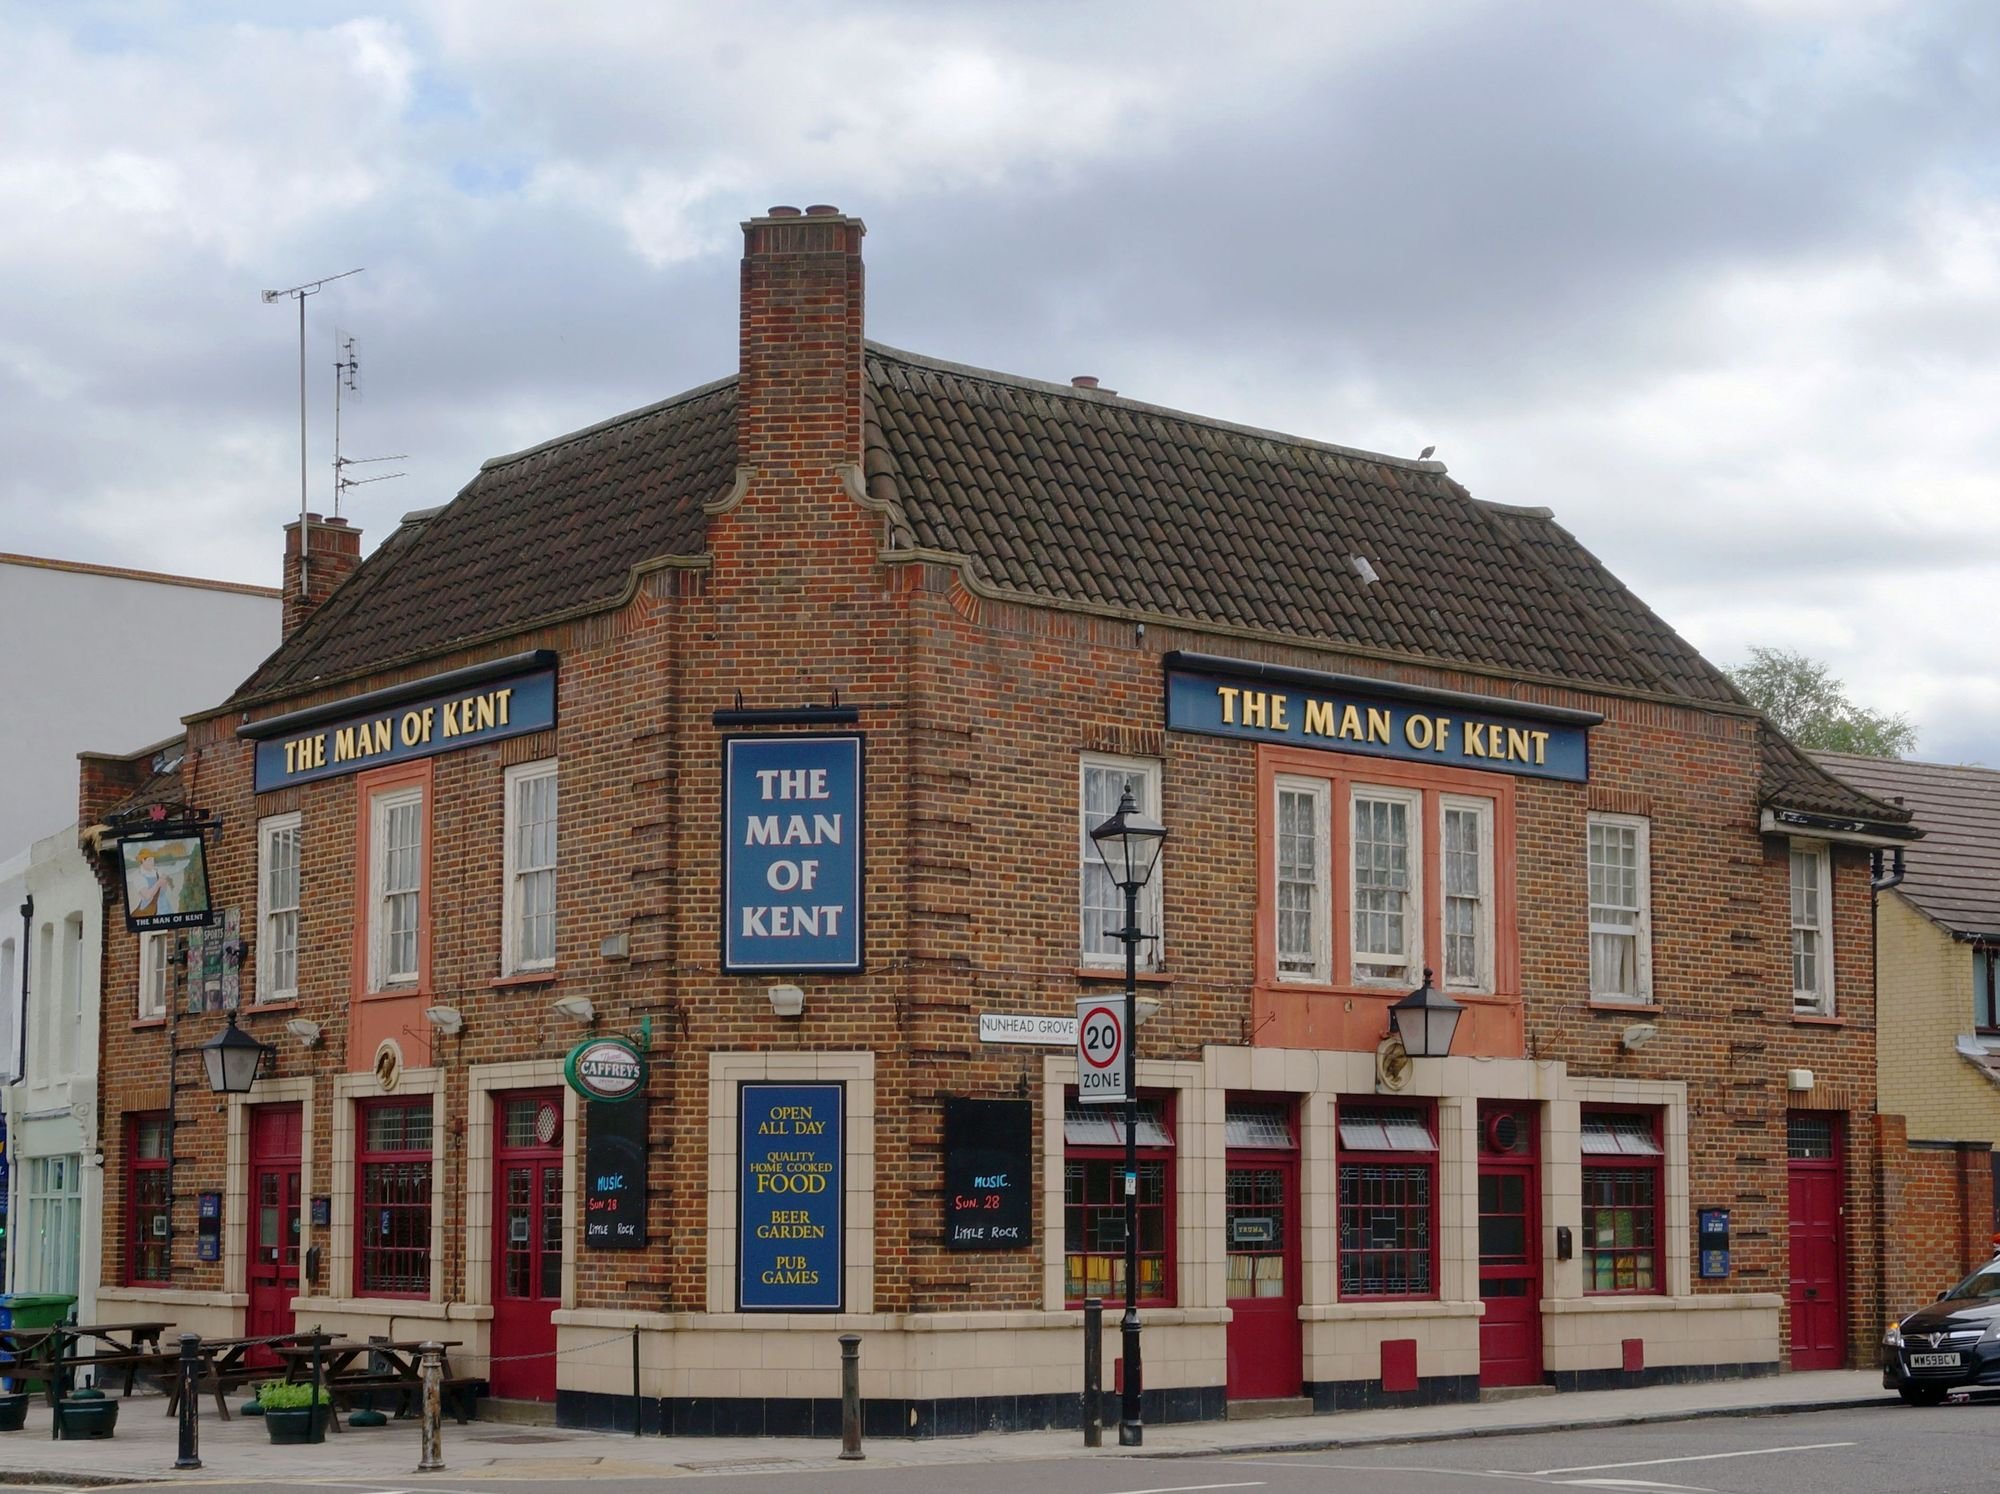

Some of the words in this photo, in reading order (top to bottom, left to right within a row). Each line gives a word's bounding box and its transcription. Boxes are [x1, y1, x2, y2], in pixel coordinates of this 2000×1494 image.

[284, 733, 327, 774] THE
[333, 717, 393, 763] MAN
[400, 706, 436, 747] OF
[442, 688, 512, 738] KENT
[1217, 686, 1290, 731] THE
[1303, 698, 1391, 745] MAN
[1404, 713, 1451, 752] OF
[1462, 721, 1550, 765] KENT
[755, 768, 830, 800] THE
[744, 813, 842, 845] MAN
[766, 859, 819, 891] OF
[135, 918, 150, 926] THE
[152, 916, 170, 924] MAN
[185, 913, 204, 921] KENT
[741, 904, 844, 937] KENT
[204, 927, 224, 941] SPORTS
[981, 1018, 1035, 1033] NUNHEAD
[1038, 1020, 1074, 1034] GROVE
[1086, 1025, 1115, 1050] 20
[1083, 1072, 1121, 1088] ZONE
[769, 1106, 813, 1120] OPEN
[758, 1121, 789, 1135] ALL
[795, 1121, 826, 1135] DAY
[767, 1151, 815, 1162] QUALITY
[750, 1163, 783, 1173] HOME
[786, 1163, 833, 1173] COOKED
[756, 1173, 826, 1194] FOOD
[607, 1198, 618, 1211] 28
[983, 1195, 1000, 1209] 28
[771, 1210, 810, 1224] BEER
[617, 1222, 635, 1236] ROCK
[756, 1225, 825, 1239] GARDEN
[991, 1226, 1018, 1239] ROCK
[775, 1256, 807, 1270] PUB
[761, 1271, 819, 1285] GAMES
